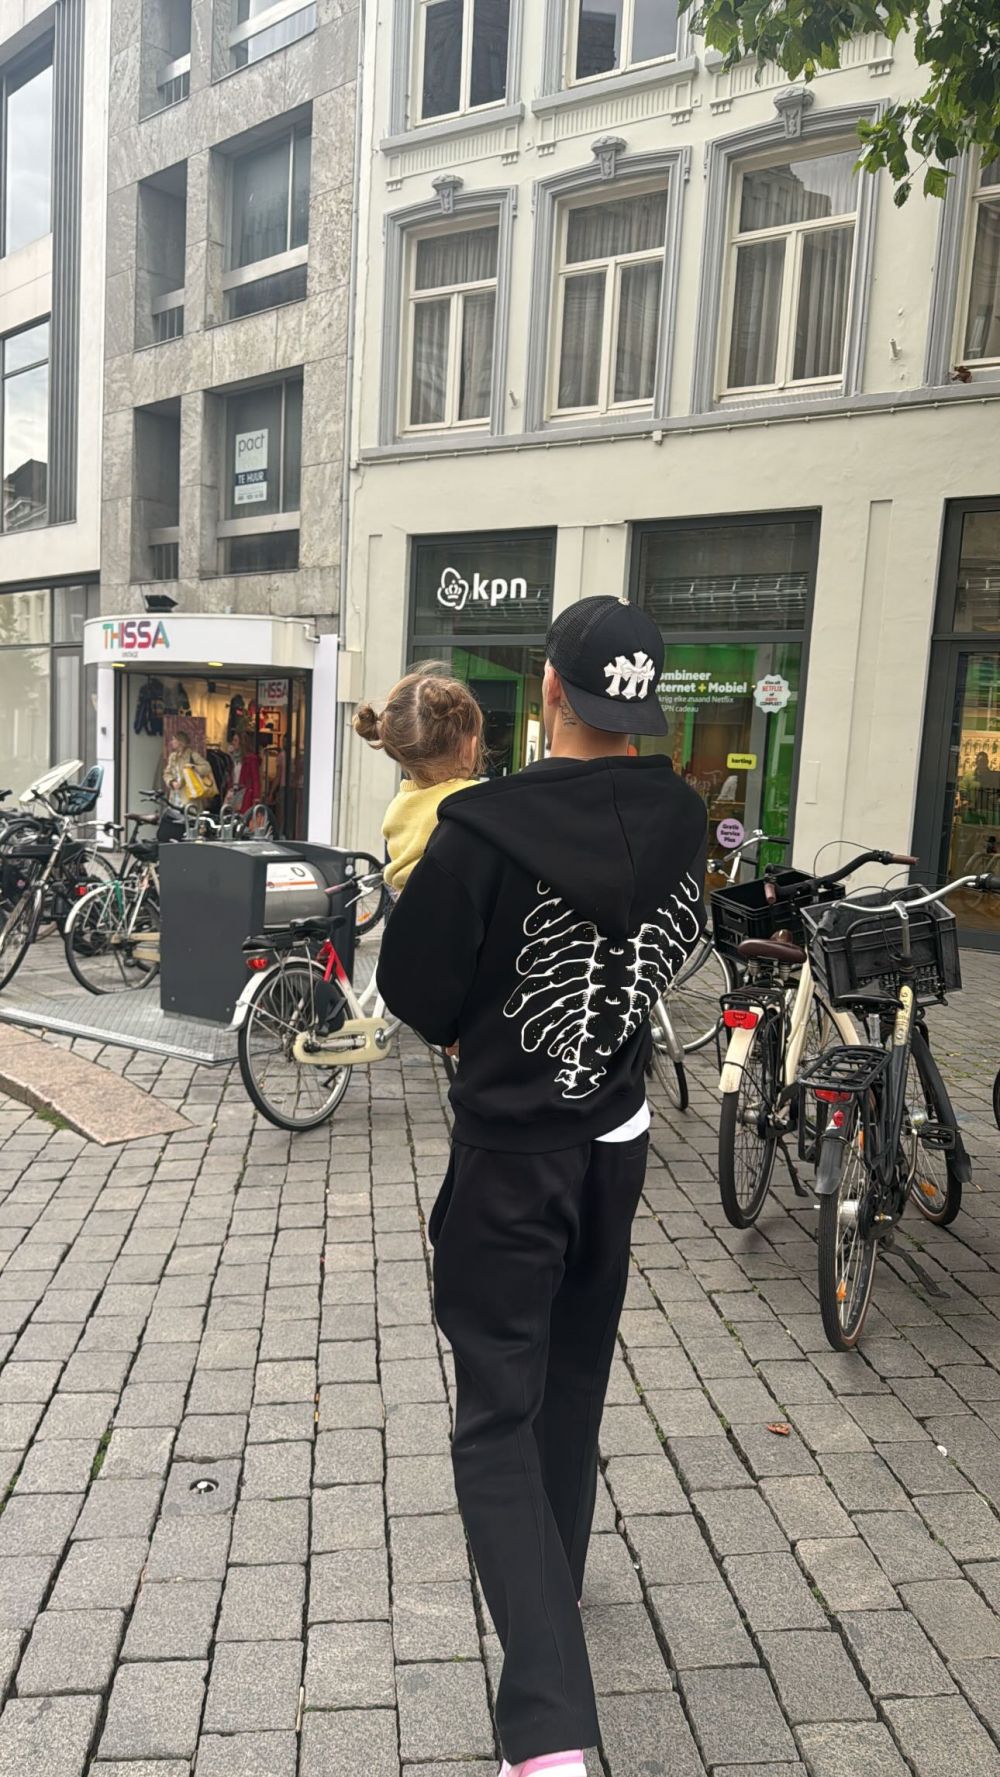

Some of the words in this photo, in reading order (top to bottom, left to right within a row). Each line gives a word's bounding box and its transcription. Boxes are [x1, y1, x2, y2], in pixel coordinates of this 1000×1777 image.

[238, 433, 265, 458] pact
[238, 474, 246, 484] TE
[246, 471, 265, 483] HUUR
[473, 572, 527, 607] kpn
[102, 621, 170, 649] THISSA
[660, 669, 712, 681] ombineer
[708, 682, 747, 693] Mobiel
[661, 704, 675, 713] SPN
[675, 704, 699, 713] cadeau
